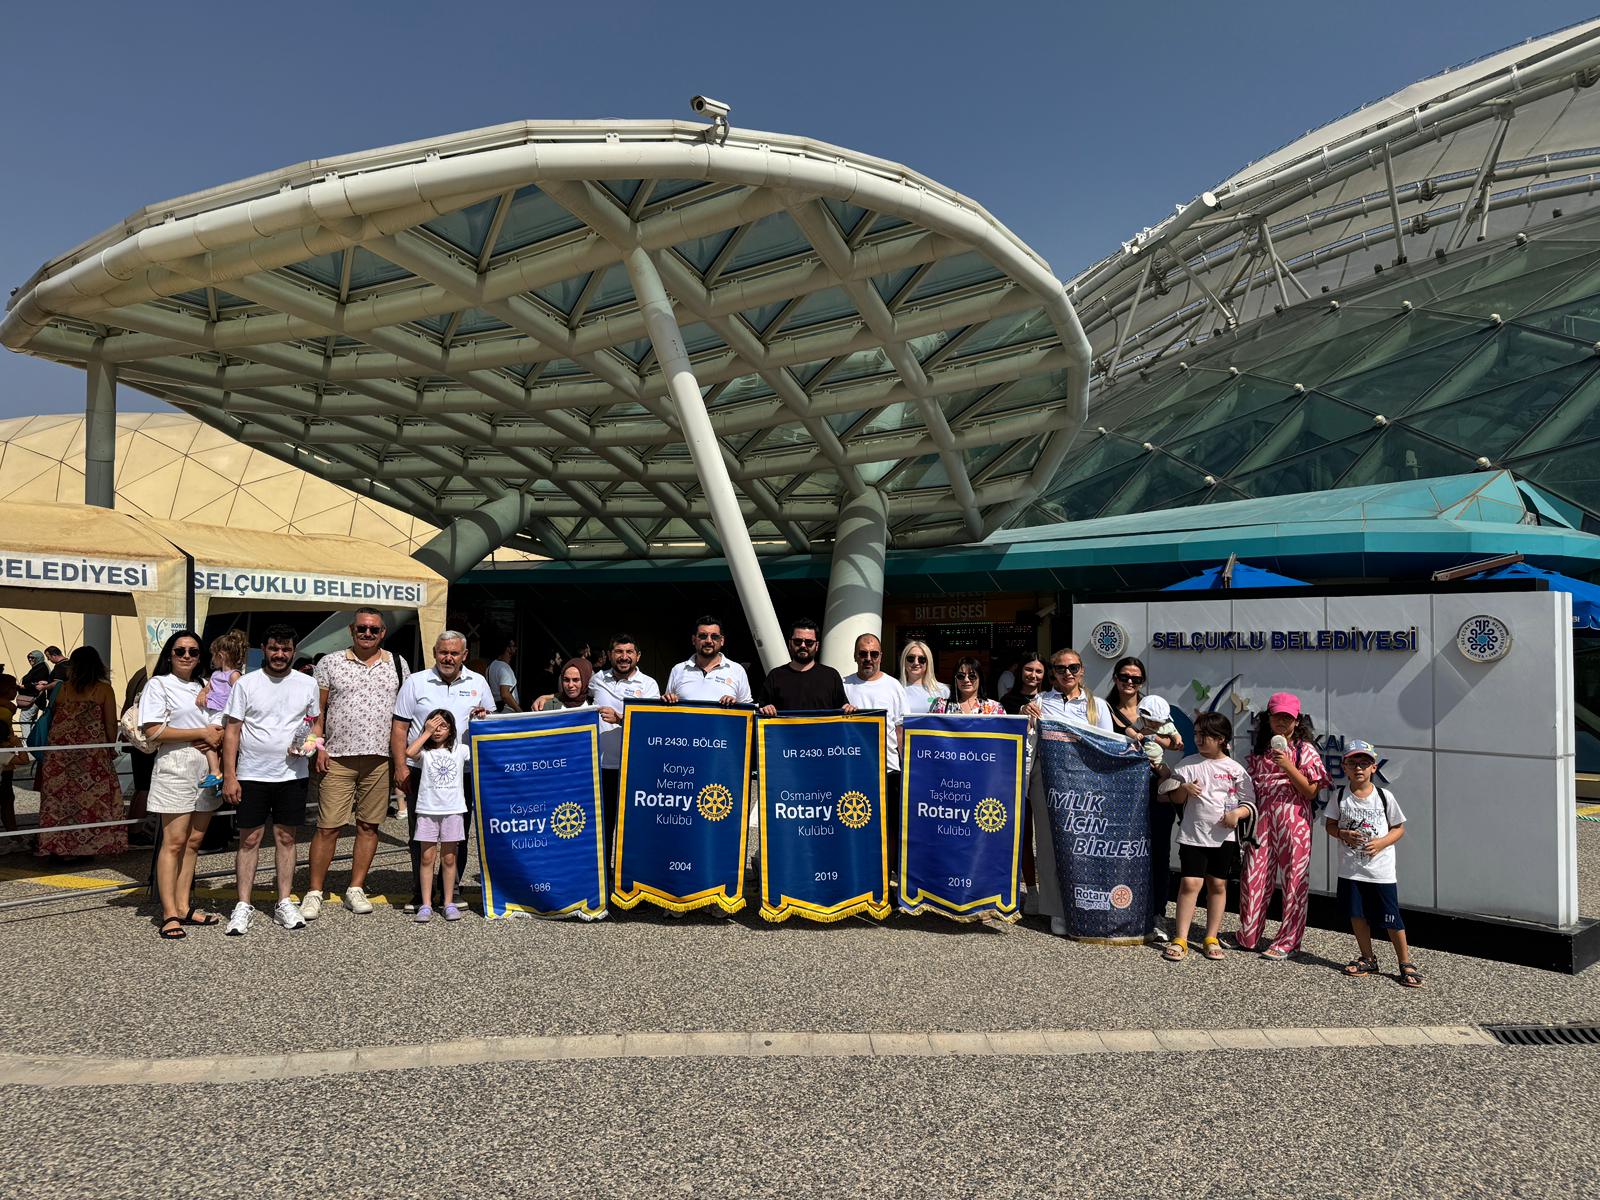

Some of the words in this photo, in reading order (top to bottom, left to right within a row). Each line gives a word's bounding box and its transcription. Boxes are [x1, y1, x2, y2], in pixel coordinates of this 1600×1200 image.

[194, 571, 307, 596] SELÇUKLU
[313, 579, 421, 602] BELEDİYESİ
[914, 603, 946, 620] BİLET
[1152, 630, 1265, 653] SELÇUKLU
[1271, 626, 1418, 652] BELEDİYESİ
[648, 737, 663, 746] UR
[665, 737, 690, 747] 2430.
[692, 736, 728, 749] BÖLGE
[783, 749, 798, 758] UR
[800, 748, 825, 758] 2430.
[827, 745, 861, 757] BÖLGE
[917, 750, 932, 759] UR
[934, 751, 957, 761] 2430
[959, 751, 996, 762] BÖLGE
[504, 763, 530, 773] 2430.
[532, 758, 567, 770] BÖLGE
[663, 762, 695, 775] Konya
[656, 778, 694, 790] Meram
[940, 778, 971, 789] Adana
[634, 790, 693, 811] Rotary
[780, 790, 832, 802] Osmaniye
[929, 789, 971, 803] Taşköprü
[1047, 788, 1105, 812] İYİLİK
[509, 801, 547, 816] Kayseri
[775, 802, 832, 821] Rotary
[918, 803, 971, 823] Rotary
[490, 817, 547, 835] Rotary
[656, 813, 692, 826] Kulübü
[1064, 811, 1108, 835] İÇİN
[798, 825, 834, 837] Kulübü
[937, 825, 971, 837] Kulübü
[511, 837, 548, 850] Kulübü
[669, 861, 692, 871] 2004
[814, 871, 838, 881] 2019
[948, 877, 972, 888] 2019
[530, 882, 551, 893] 1986
[1075, 887, 1111, 902] Rotary
